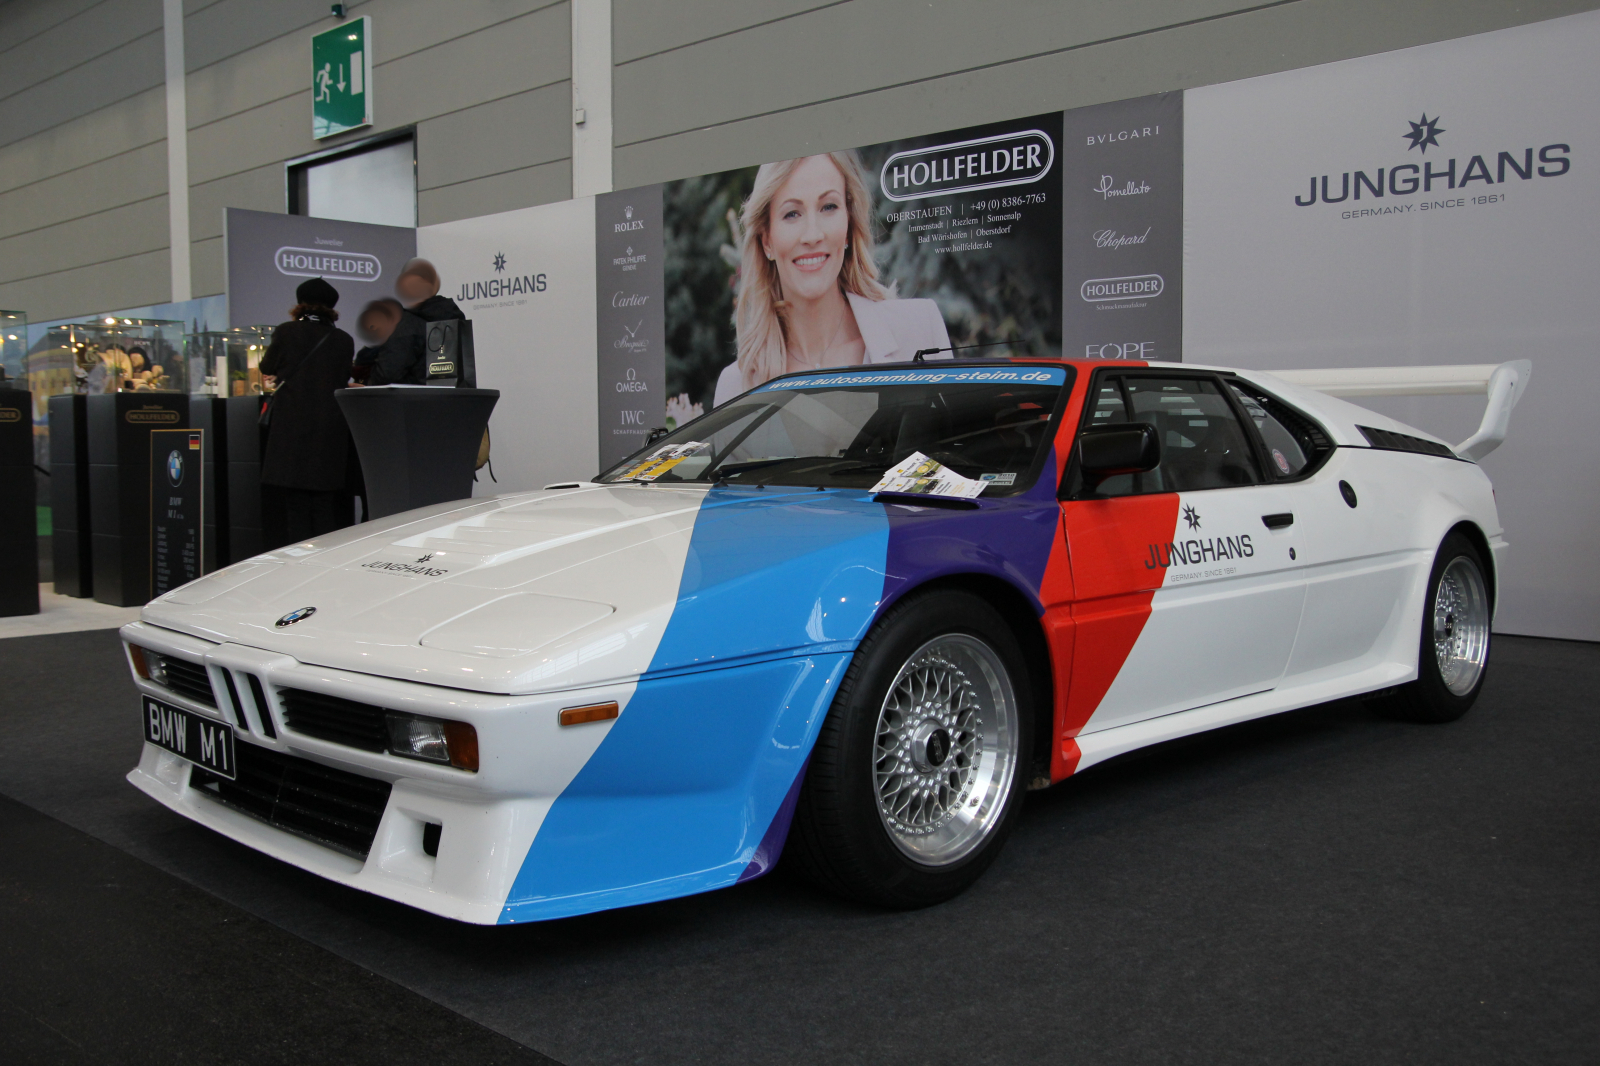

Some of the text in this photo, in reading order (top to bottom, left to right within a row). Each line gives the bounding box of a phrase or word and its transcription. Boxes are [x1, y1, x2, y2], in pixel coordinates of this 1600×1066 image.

[1087, 125, 1159, 146] BVLGARI
[893, 143, 1042, 189] HOLLFELDER
[1294, 143, 1571, 207] JUNGHANS
[1093, 174, 1151, 200] Pomellato
[886, 192, 1046, 223] OBERSTAUFEN +49 (0) 8386-7763
[1341, 193, 1506, 220] GERMANY. SINCE 1861
[614, 220, 644, 233] ROLEX
[908, 211, 1022, 233] Immenstadt Riezlern Sonnenalp
[918, 225, 1012, 244] Bad Wörishofen Oberstdorf
[1093, 226, 1151, 250] Chopard
[934, 240, 993, 254] www.hollfelder.de
[282, 253, 374, 275] HOLLFELDER
[456, 273, 547, 302] JUNGHANS
[1086, 280, 1159, 297] HOLLFELDER
[612, 290, 650, 308] Cartier
[615, 381, 648, 393] OMEGA
[768, 370, 1052, 390] www.autosammlung-steim.de
[620, 410, 645, 425] IWC
[1144, 534, 1254, 570] JUNGHANS
[361, 560, 449, 577] JUNGHANS
[1204, 568, 1223, 578] SINCE
[149, 702, 228, 771] BMW M1
